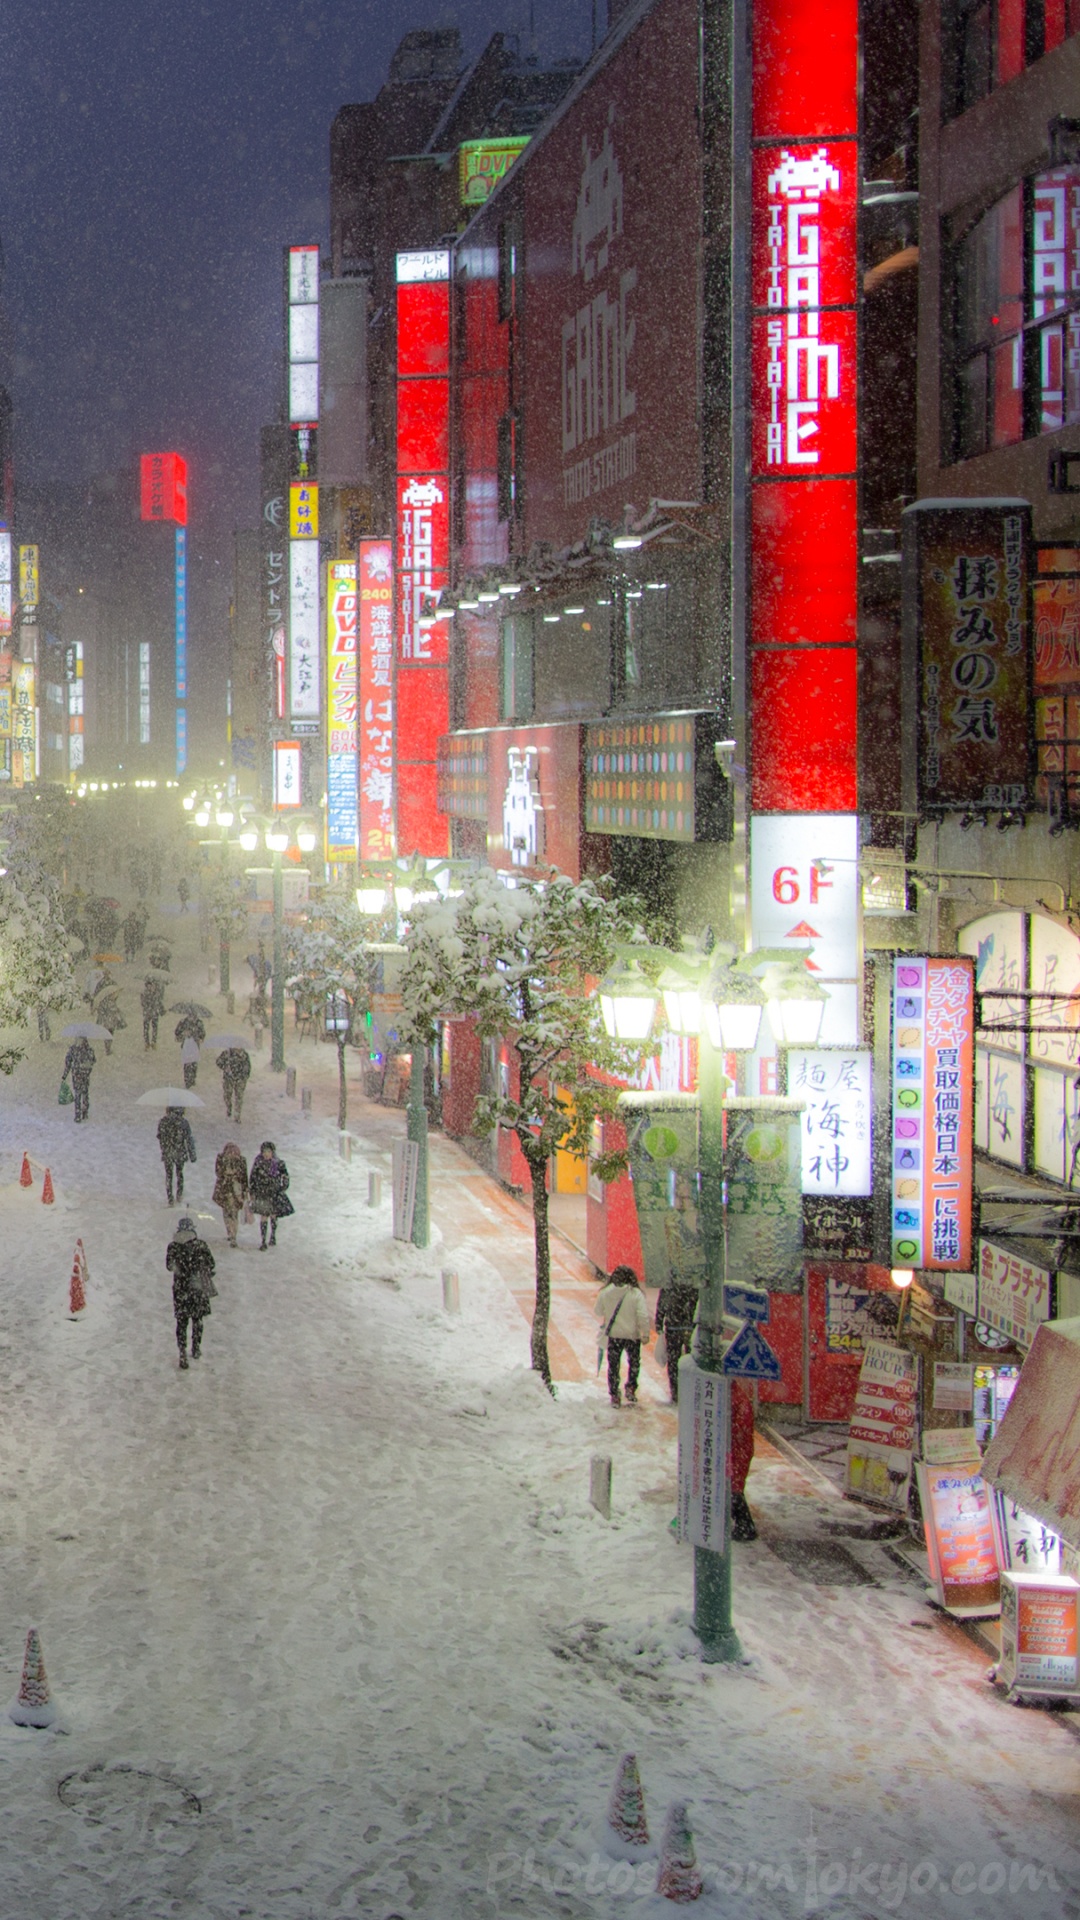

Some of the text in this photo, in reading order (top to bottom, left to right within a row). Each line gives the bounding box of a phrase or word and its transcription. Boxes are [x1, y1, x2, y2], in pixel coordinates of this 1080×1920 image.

[398, 254, 445, 265] ワールド
[423, 268, 447, 280] ビル
[767, 205, 782, 464] TAITO STATION
[787, 203, 838, 464] GAME
[361, 589, 391, 599] 240
[371, 605, 391, 686] 海鮮居酒屋
[773, 866, 834, 904] 6F
[927, 969, 947, 1045] プラチナ
[948, 968, 969, 1046] 金ダイヤ
[796, 1058, 862, 1092] 麺屋
[807, 1100, 849, 1188] 海神
[933, 1048, 960, 1260] 買取価格日本一に挑戦
[981, 1245, 1047, 1304] 金・プラチナ
[864, 1356, 901, 1377] HOUR
[868, 1346, 902, 1363] HAPPY
